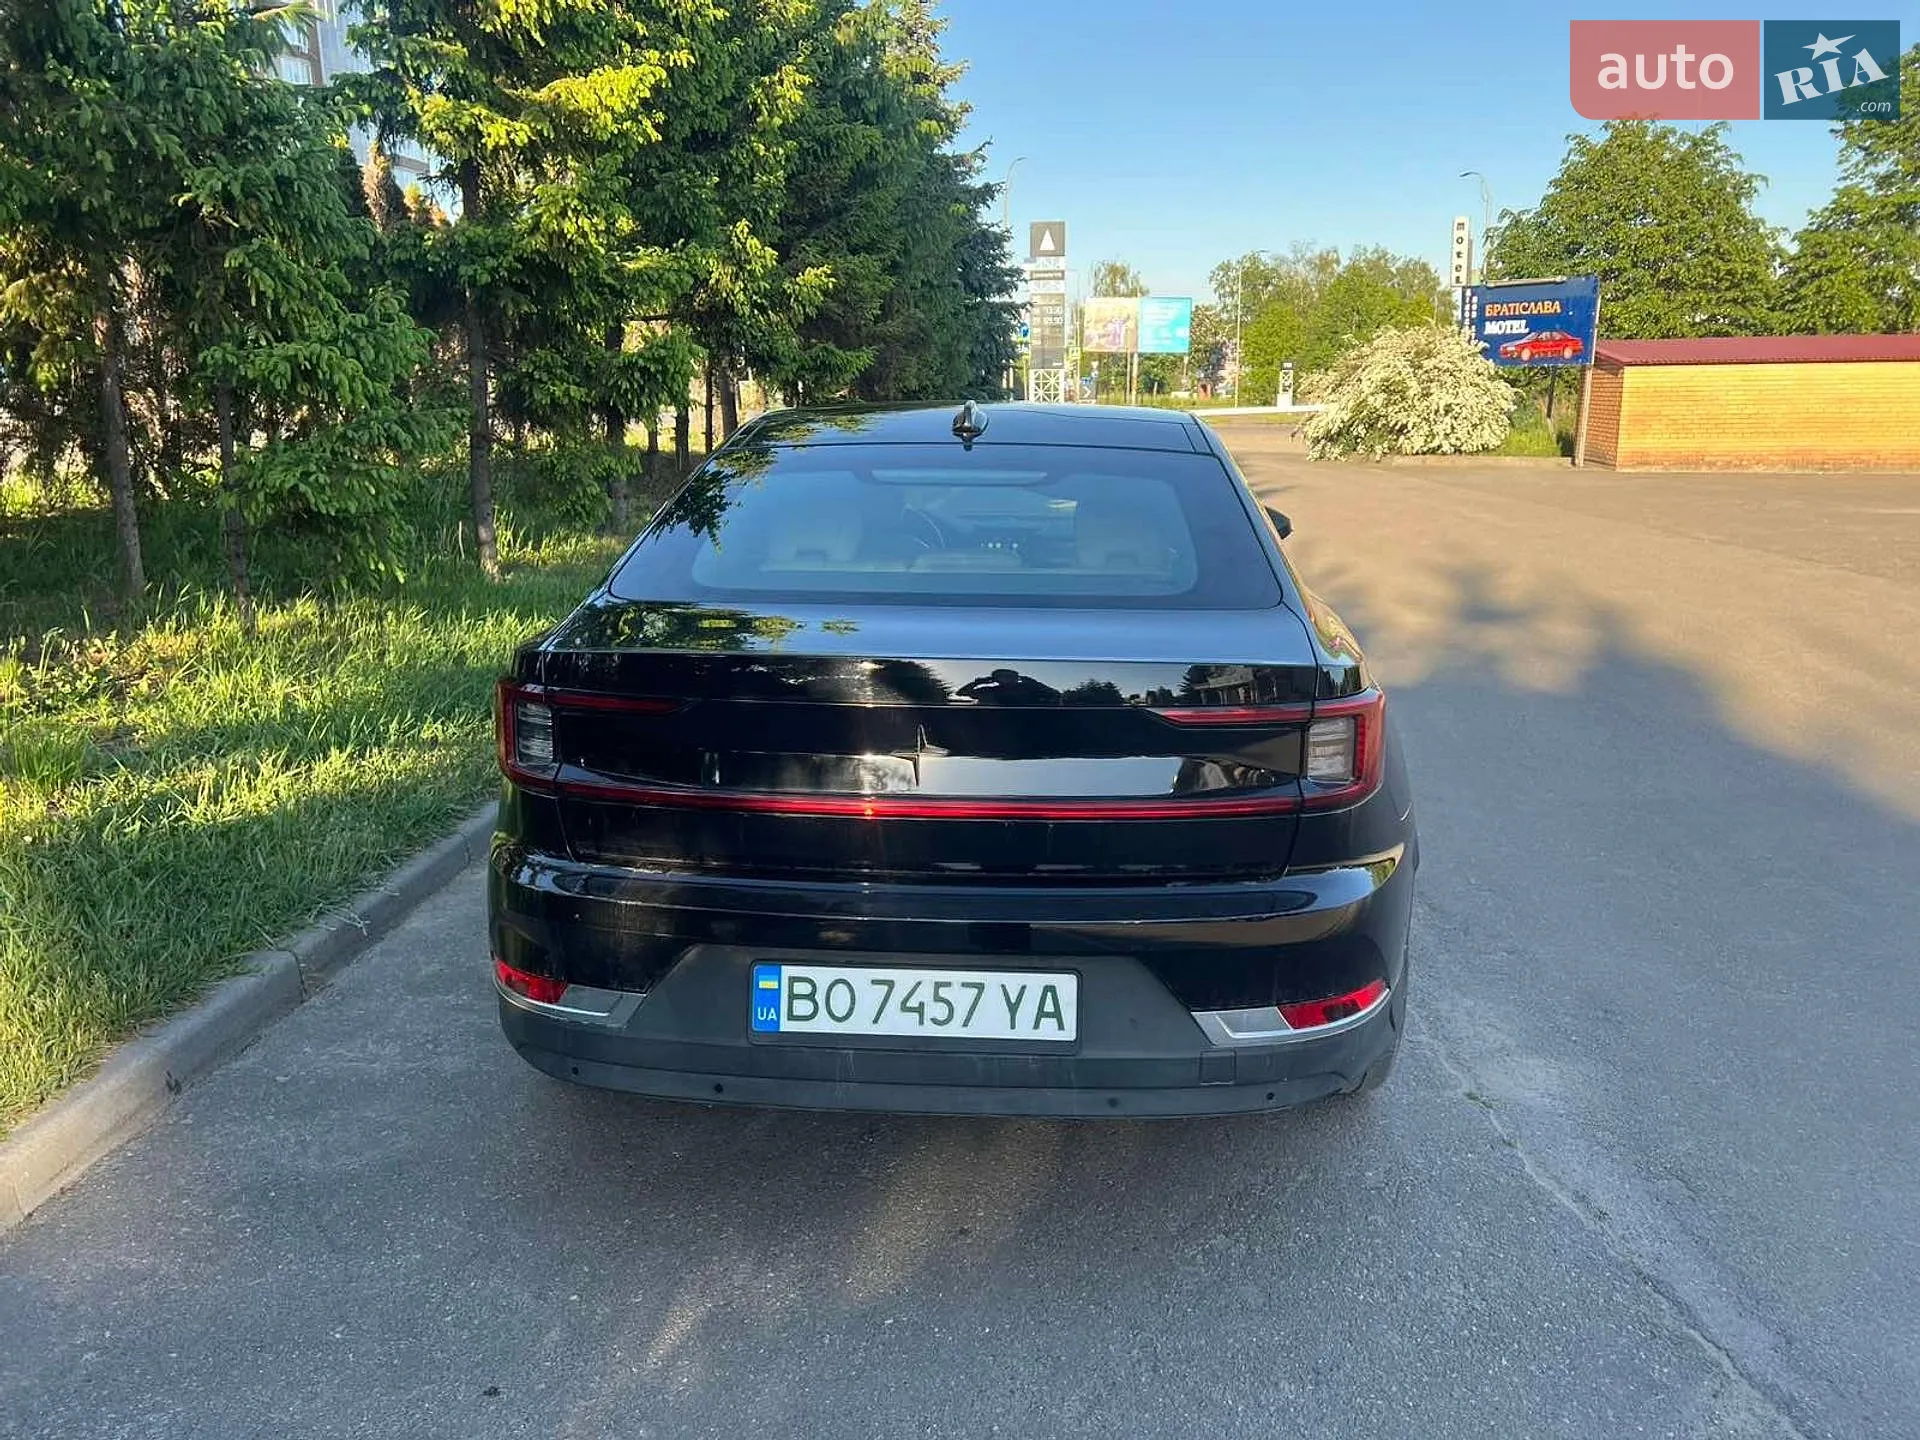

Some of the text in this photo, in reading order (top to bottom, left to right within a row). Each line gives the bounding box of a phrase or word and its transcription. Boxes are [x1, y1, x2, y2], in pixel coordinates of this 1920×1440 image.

[1485, 301, 1562, 317] БРАТІСЛАВА
[1484, 320, 1529, 335] MOTEL
[786, 975, 1066, 1031] BO 7457 YA
[757, 1007, 777, 1021] UA
